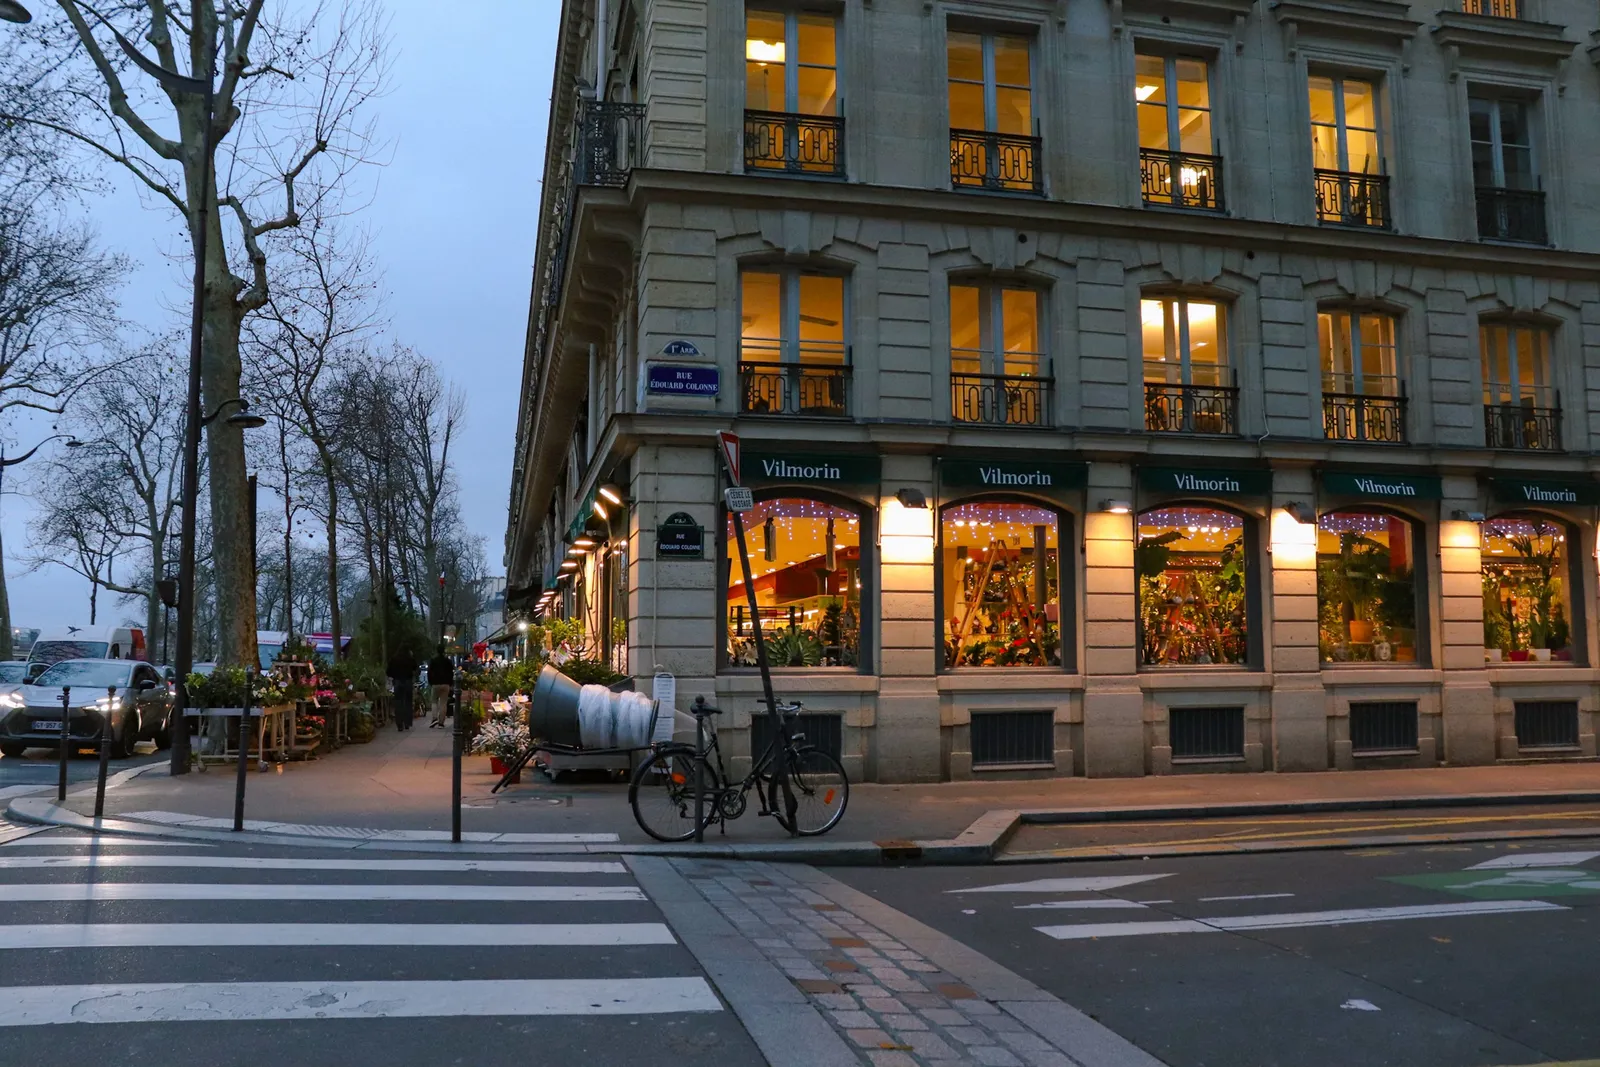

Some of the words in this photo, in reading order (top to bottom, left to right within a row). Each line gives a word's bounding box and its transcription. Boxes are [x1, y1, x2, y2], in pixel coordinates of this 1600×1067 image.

[676, 372, 693, 380] RUE
[650, 379, 684, 389] ÉDOUARD
[685, 382, 718, 391] COLONNE
[762, 459, 841, 479] Vilmorin
[979, 467, 1052, 485] Vilmorin
[1173, 473, 1240, 492] Vilmorin
[1354, 478, 1416, 496] Vilmorin
[744, 490, 751, 498] LE
[1523, 485, 1577, 502] Vilmorin
[732, 499, 752, 508] PASSAGE
